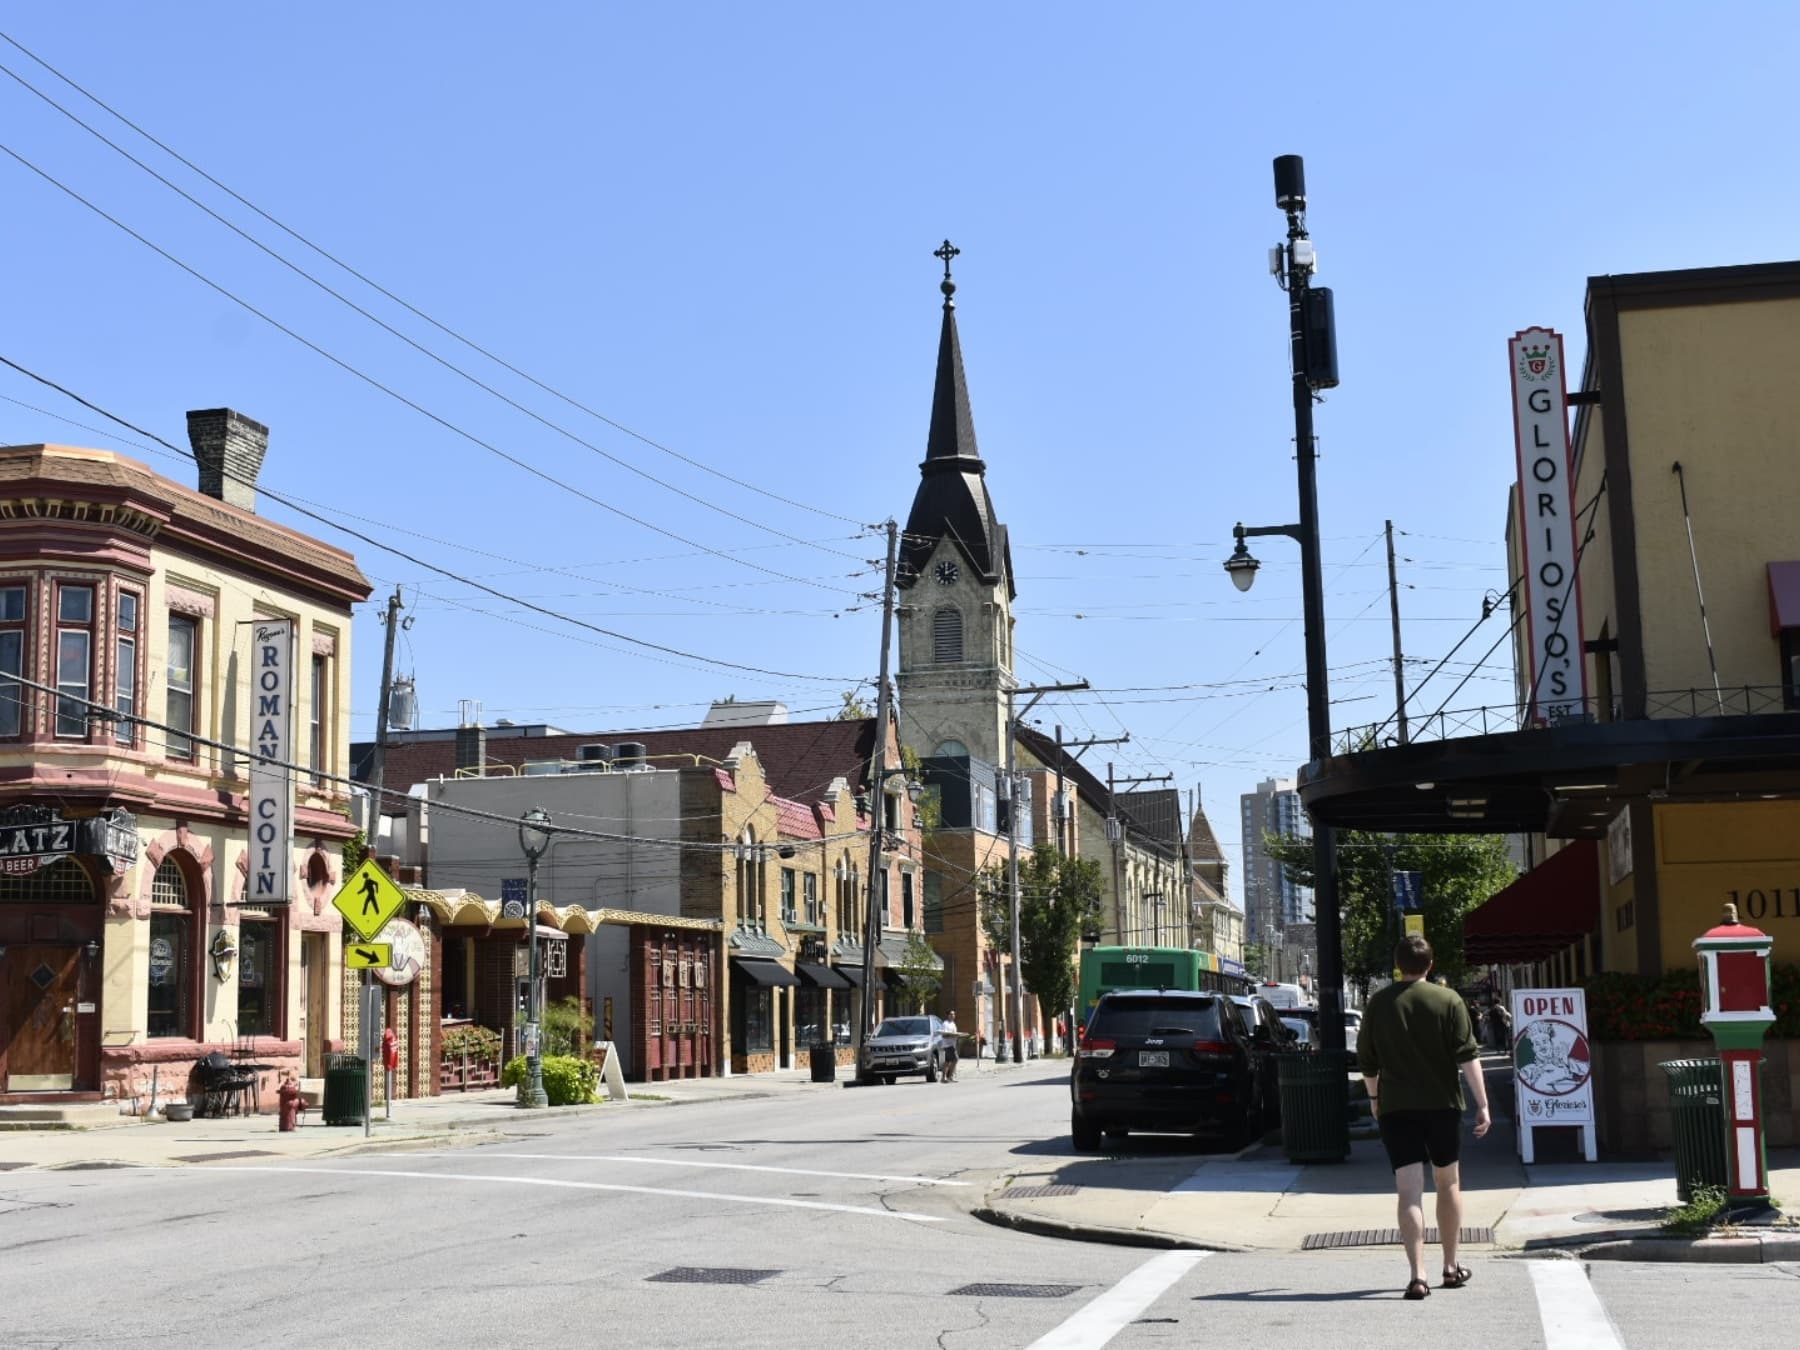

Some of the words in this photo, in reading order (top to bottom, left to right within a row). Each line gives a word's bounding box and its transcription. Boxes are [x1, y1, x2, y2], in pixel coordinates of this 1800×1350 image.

[1528, 389, 1568, 695] GLORIOSO'S
[258, 645, 280, 766] ROMAN
[6, 859, 34, 874] BEER
[256, 798, 277, 894] COIN
[1126, 954, 1149, 964] 6012
[1523, 997, 1574, 1016] OPEN
